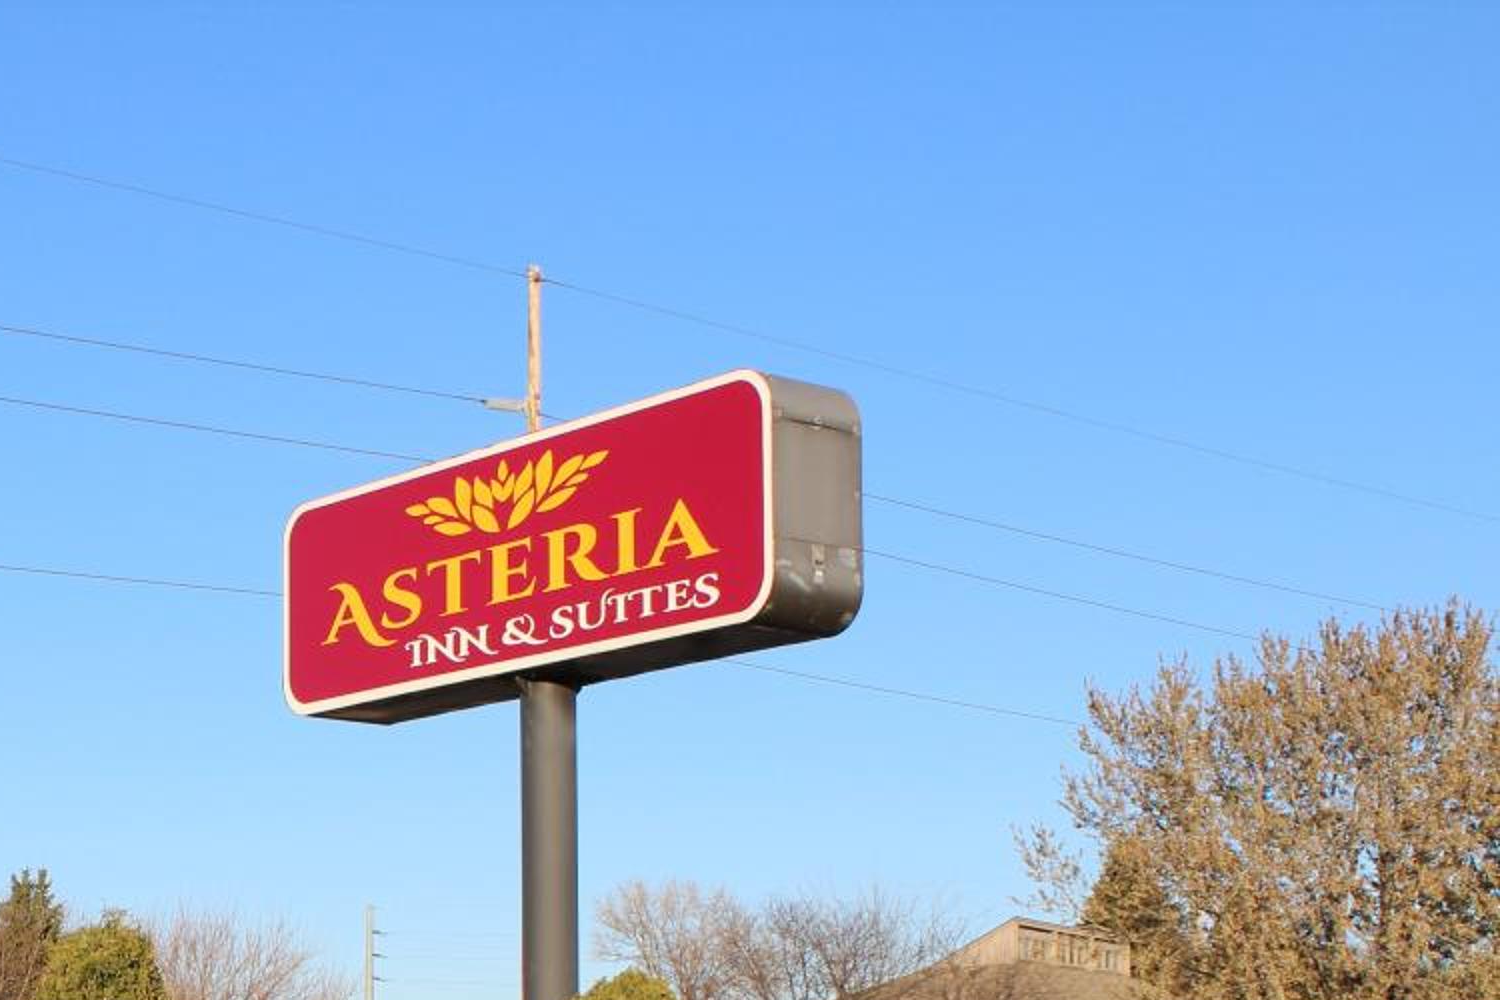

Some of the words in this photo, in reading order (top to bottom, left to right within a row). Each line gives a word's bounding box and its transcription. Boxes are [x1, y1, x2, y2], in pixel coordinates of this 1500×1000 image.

[323, 498, 719, 647] ASTERIA
[405, 624, 498, 668] INN
[502, 614, 548, 646] &
[549, 572, 721, 639] SUITES
